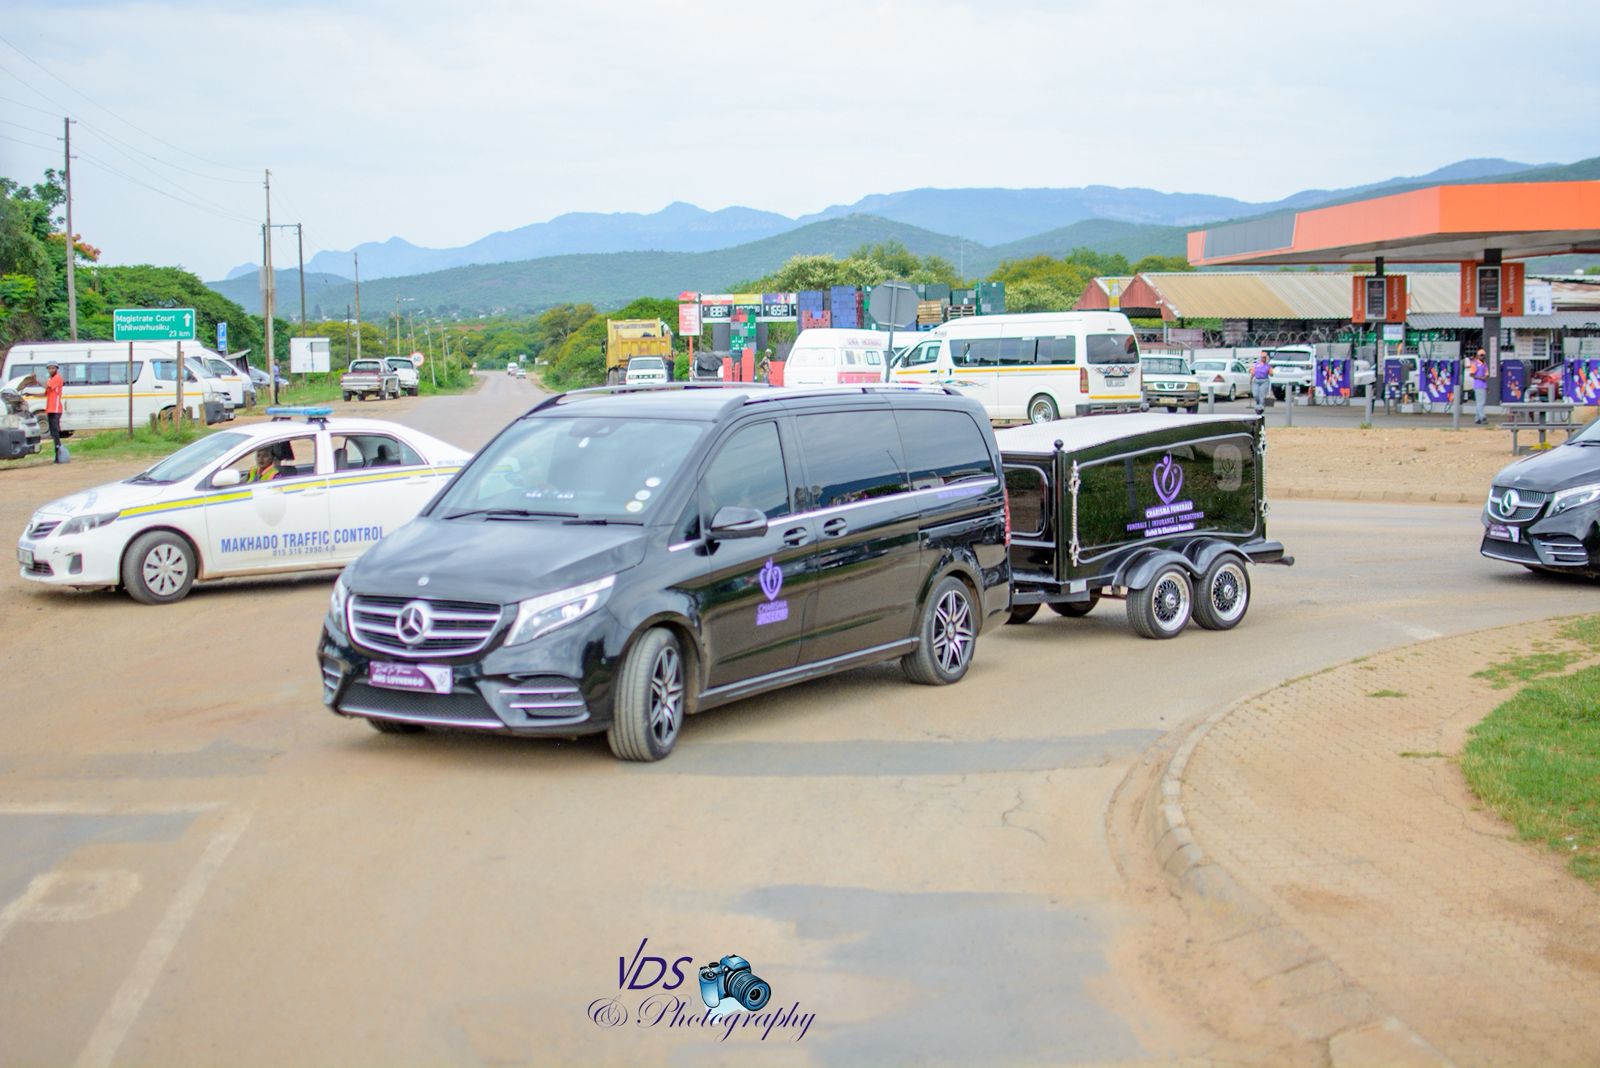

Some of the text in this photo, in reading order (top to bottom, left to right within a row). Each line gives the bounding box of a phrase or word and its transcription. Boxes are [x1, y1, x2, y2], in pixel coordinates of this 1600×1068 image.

[115, 314, 176, 323] Magistrate Court
[1146, 502, 1193, 517] CHARISMA FUNERALS
[1151, 516, 1175, 526] INSURANCE
[221, 526, 383, 553] MAKHADO TRAFFIC CONTROL
